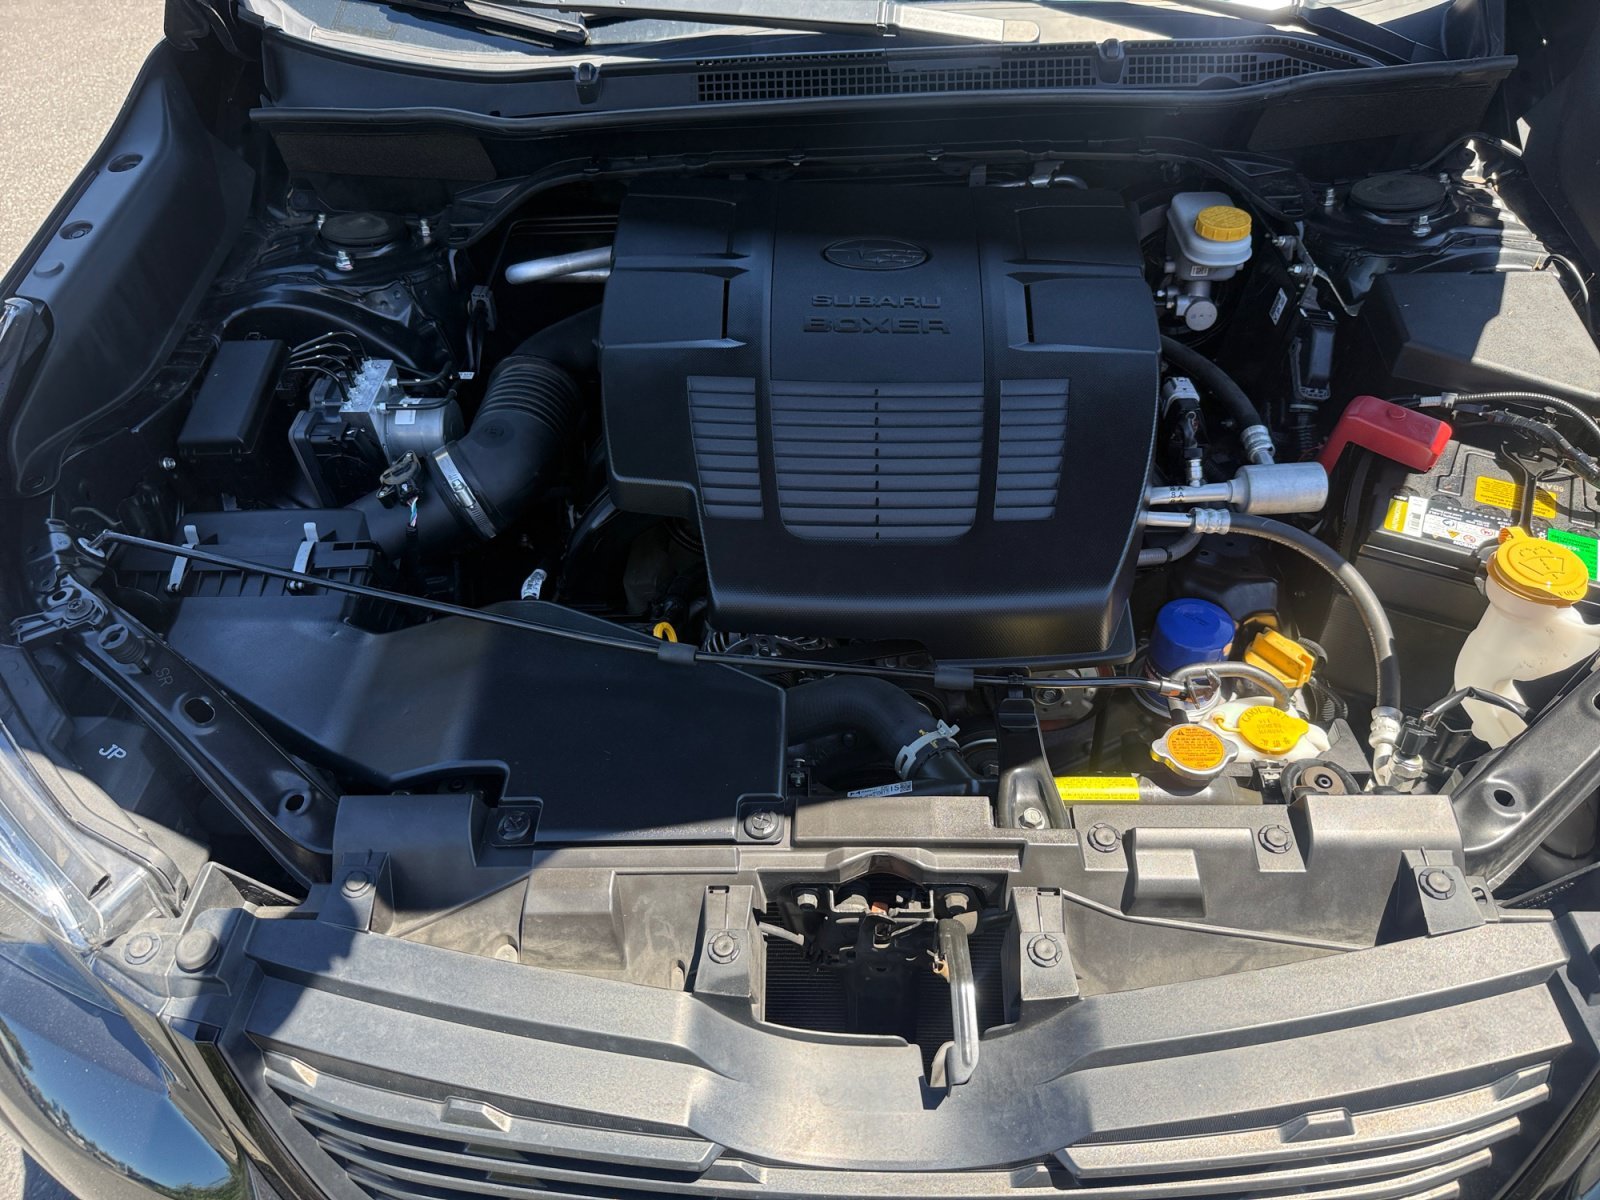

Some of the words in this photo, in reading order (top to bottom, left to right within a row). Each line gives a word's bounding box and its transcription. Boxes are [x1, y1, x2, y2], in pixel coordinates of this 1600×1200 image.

[811, 295, 942, 308] SUBARU
[803, 316, 950, 334] BOXER
[155, 667, 174, 688] SR
[1241, 707, 1289, 723] COOLANT
[99, 743, 127, 760] JP
